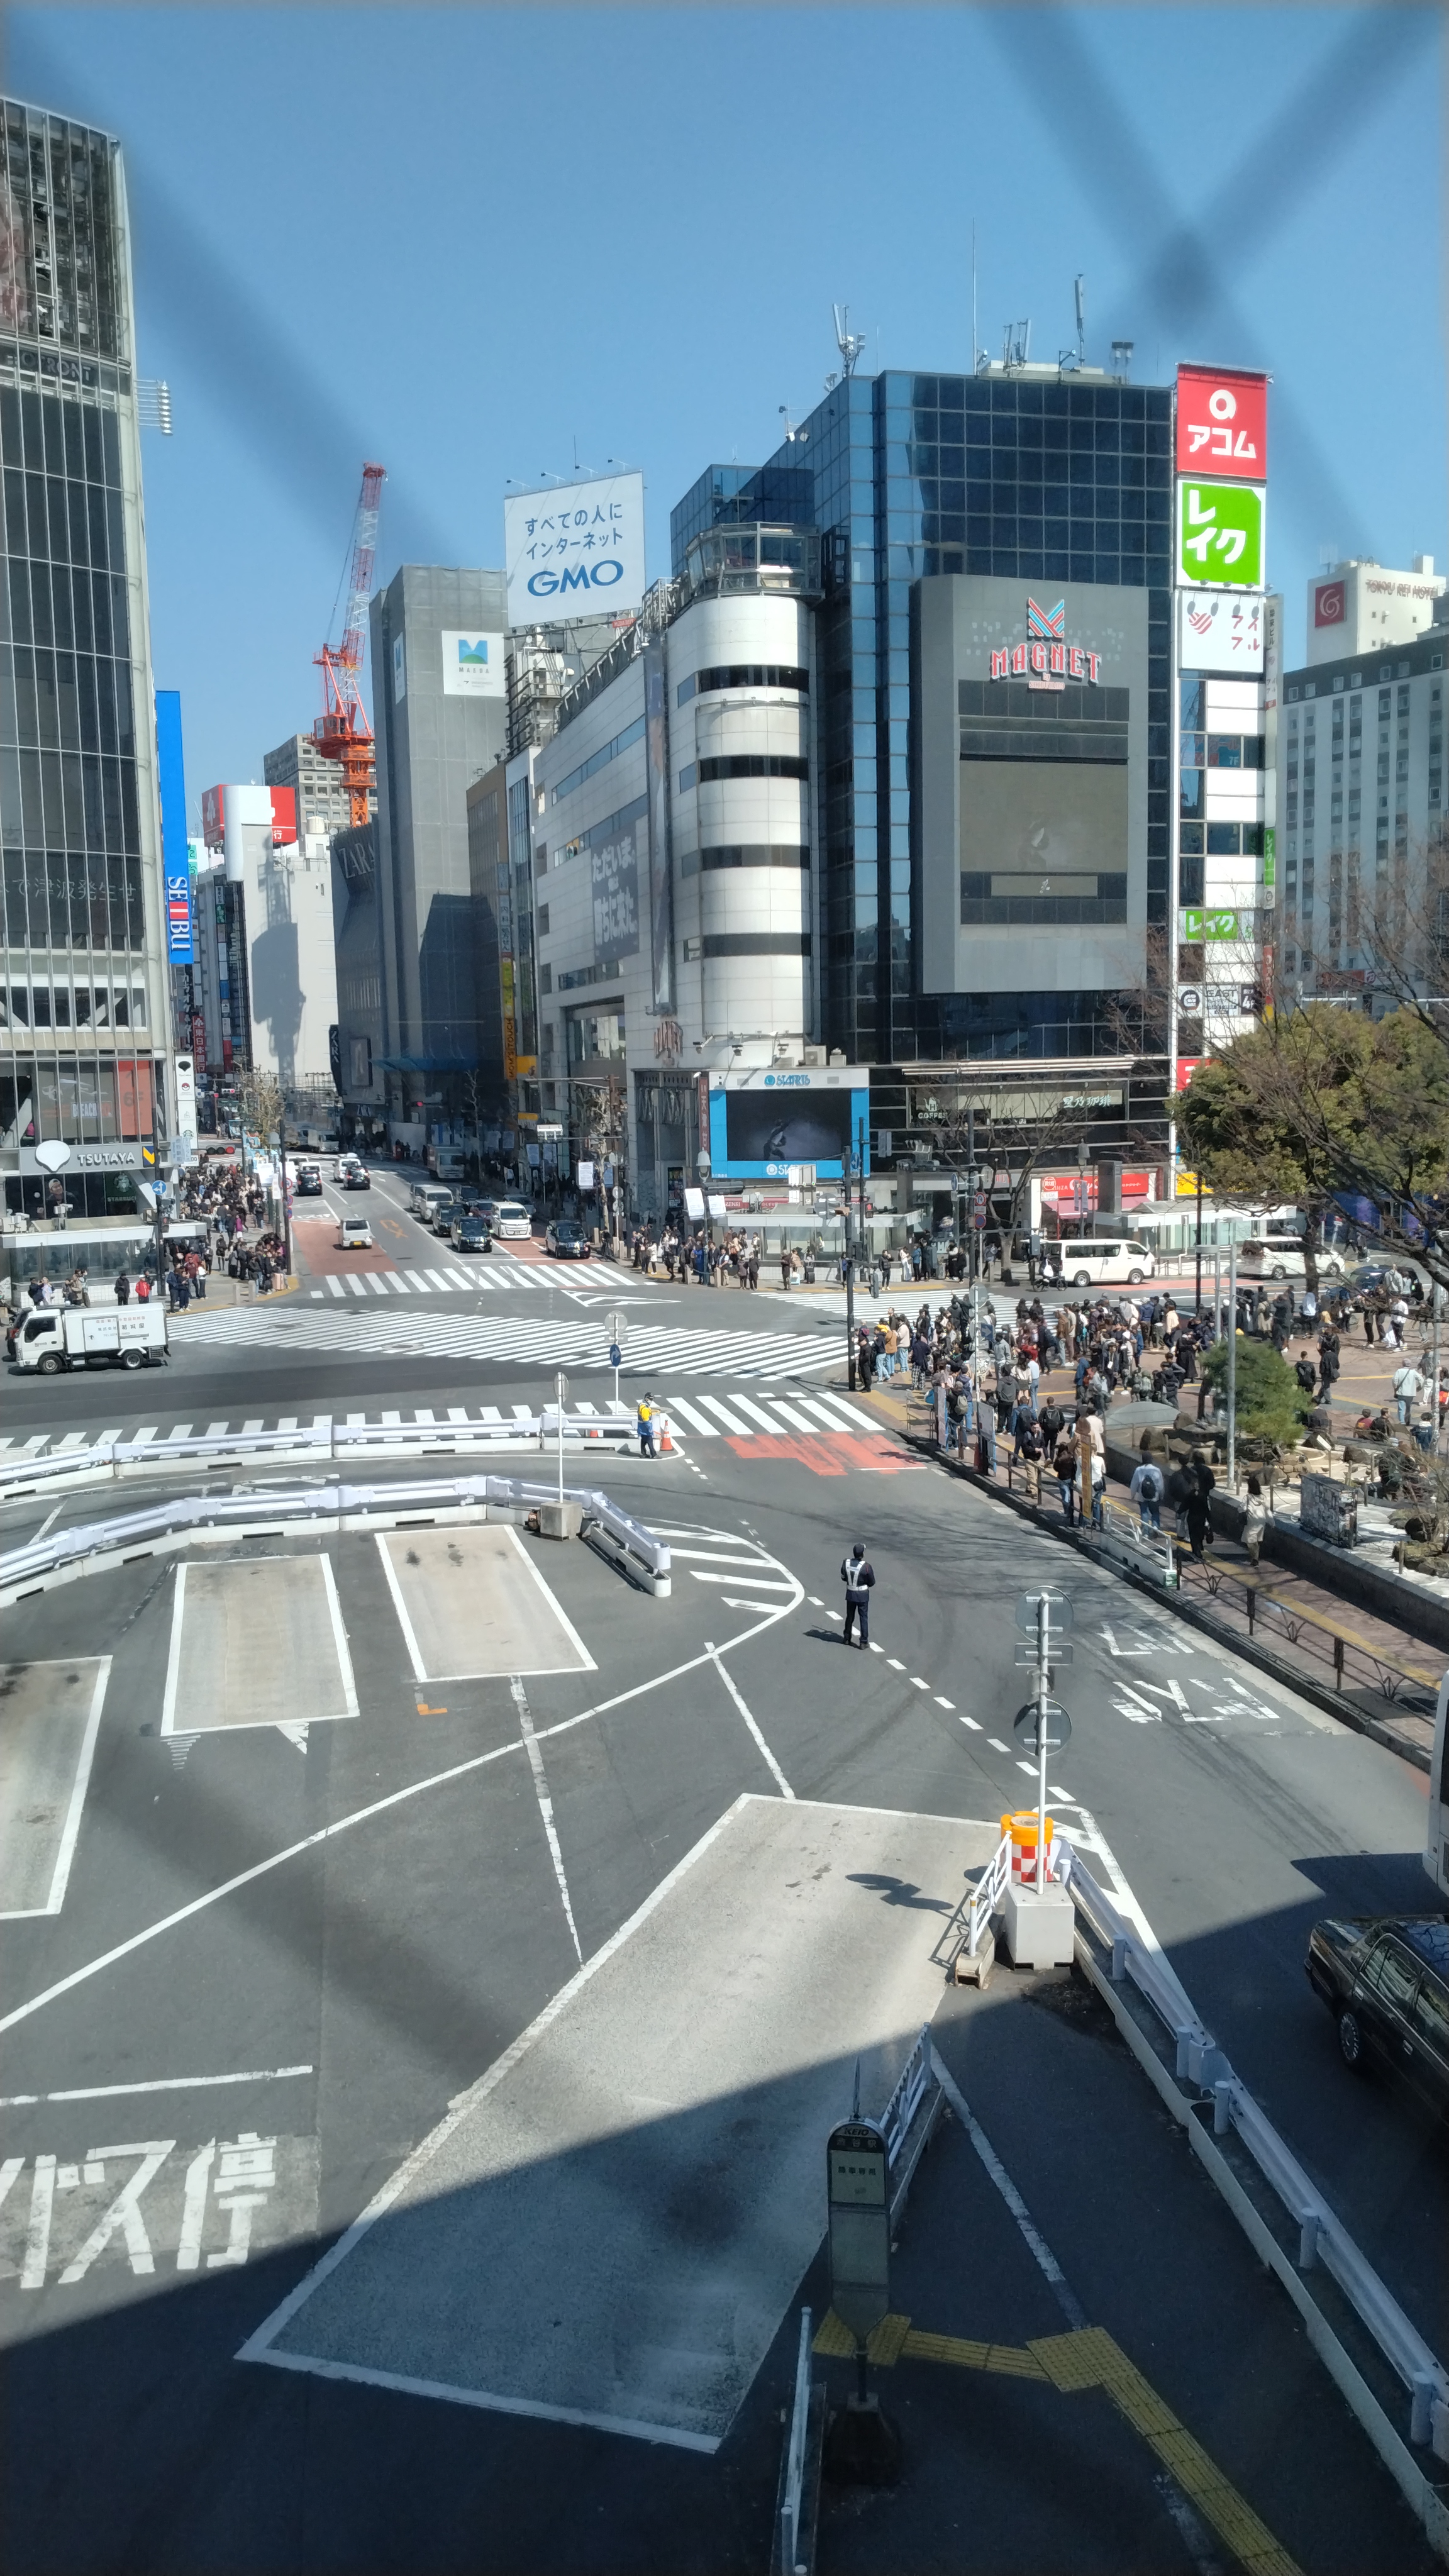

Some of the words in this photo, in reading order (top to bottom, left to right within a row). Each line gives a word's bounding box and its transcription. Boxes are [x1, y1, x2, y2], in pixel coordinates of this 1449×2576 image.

[1187, 425, 1257, 458] アコム
[525, 502, 623, 537] すべての人に
[526, 527, 623, 560] インターネット
[527, 560, 625, 597] GMO
[1231, 615, 1260, 631] アイ
[1231, 636, 1260, 651] フル
[991, 642, 1102, 684] MAGNET
[1229, 756, 1240, 766] 7F
[0, 877, 136, 901] で津波発生せ
[168, 877, 191, 952] SEIBU
[1189, 915, 1235, 933] レイク
[194, 1028, 206, 1073] 東日本銀行
[72, 1103, 97, 1118] BLEACH
[77, 1152, 135, 1164] TSUTAYA
[844, 2127, 870, 2136] KEIO
